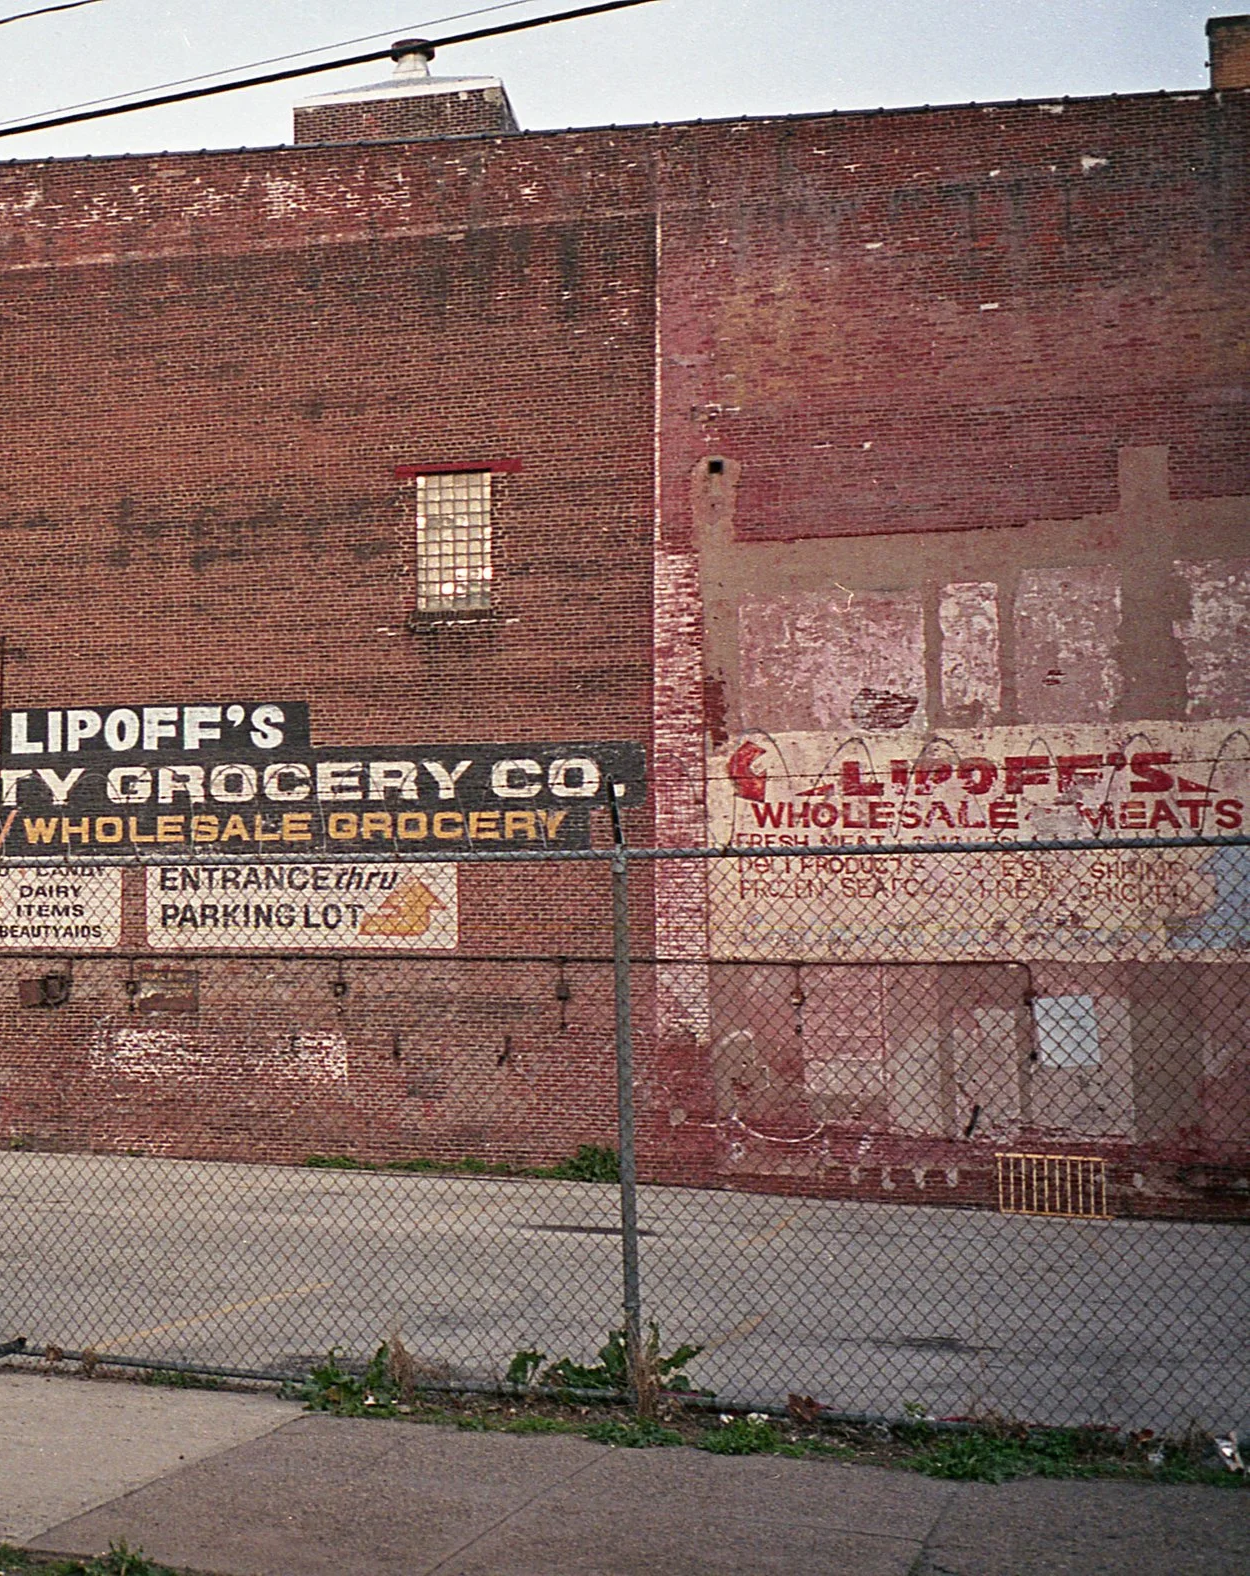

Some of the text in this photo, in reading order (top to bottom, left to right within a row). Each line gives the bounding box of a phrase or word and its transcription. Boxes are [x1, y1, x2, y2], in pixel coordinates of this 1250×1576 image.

[10, 703, 286, 755] LIPOFF'S
[105, 759, 474, 806] GROCERY
[326, 809, 569, 843] GROCERY
[750, 798, 1245, 830] WHOLESALE MEATS
[19, 884, 83, 899] DAIRY
[159, 866, 401, 892] ENTRANCE thru
[16, 903, 86, 918] ITEMS
[160, 902, 366, 930] PARKING LOT
